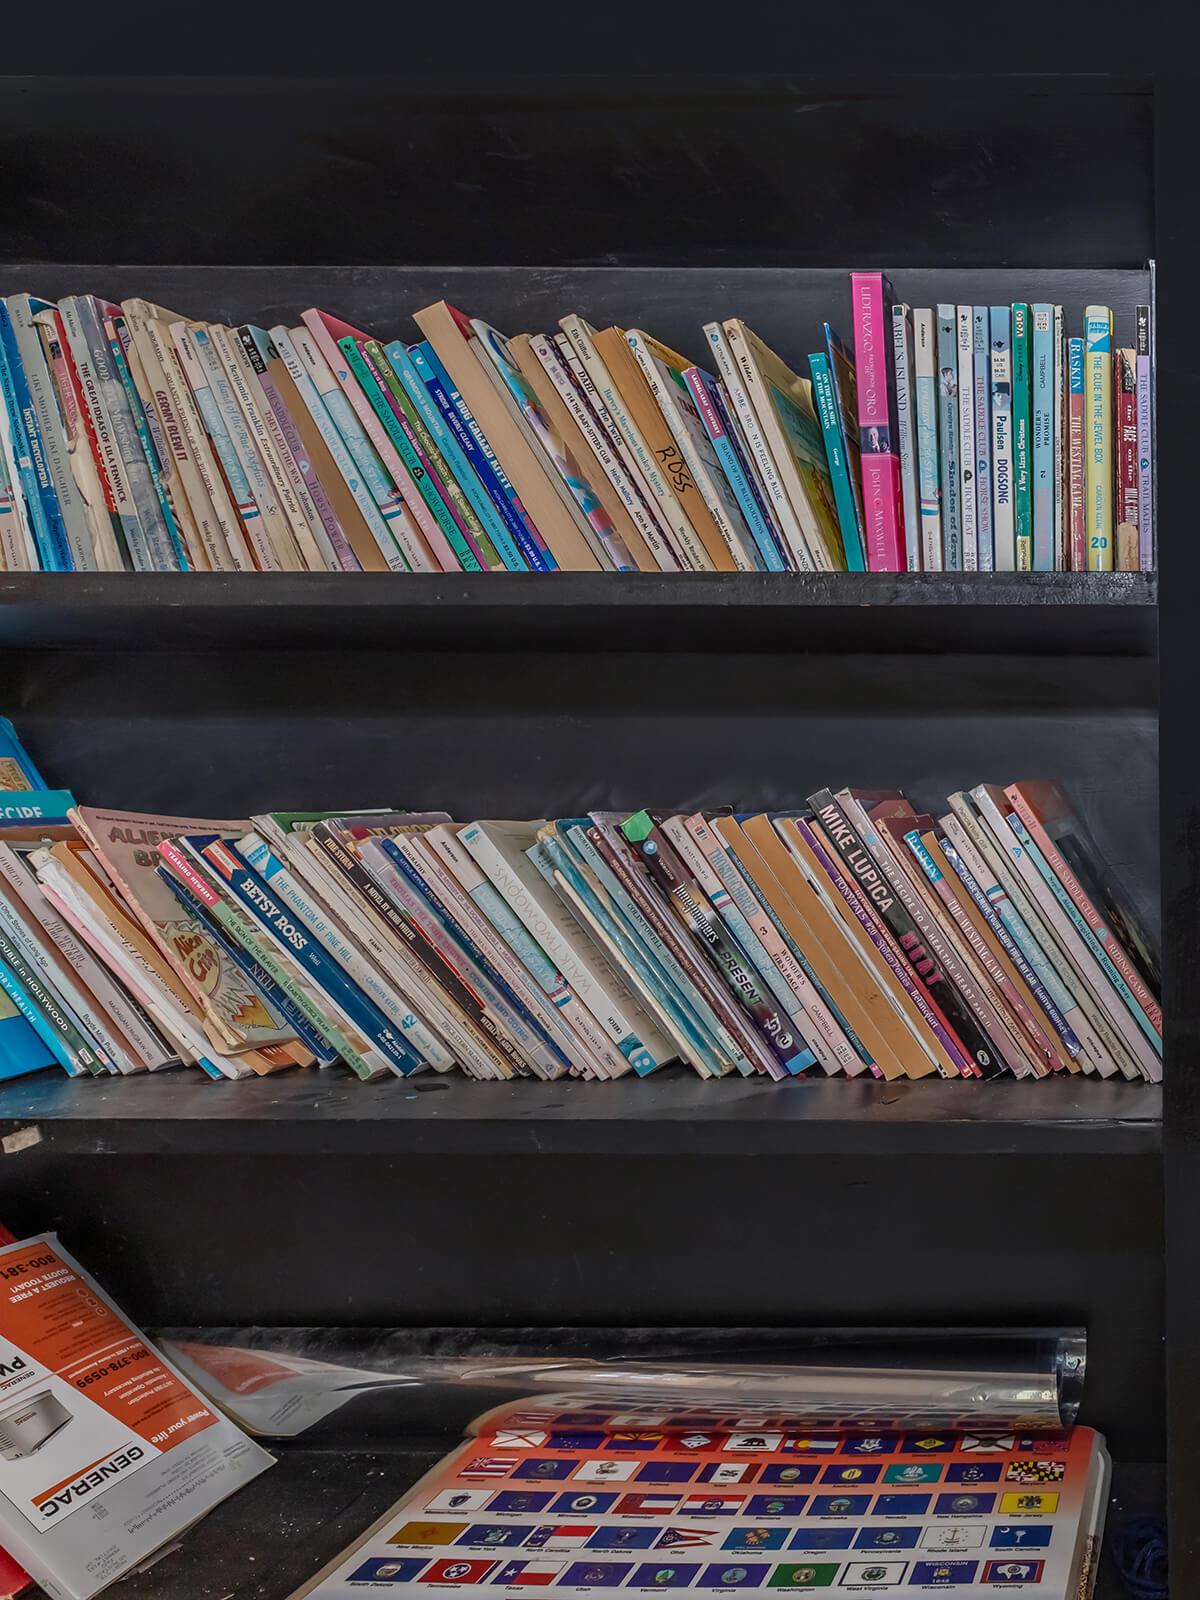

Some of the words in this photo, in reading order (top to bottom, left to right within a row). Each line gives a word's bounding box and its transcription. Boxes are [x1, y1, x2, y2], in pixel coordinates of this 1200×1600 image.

[892, 320, 904, 361] ABEL'S
[79, 361, 91, 379] THE
[1070, 343, 1081, 390] RASKIN
[83, 378, 99, 405] GREAT
[449, 390, 460, 400] A
[576, 369, 596, 396] DAHL
[597, 405, 611, 423] The
[606, 421, 624, 446] Twits
[894, 366, 907, 412] ISLAND
[91, 404, 107, 431] IDEAS
[153, 388, 177, 425] GERMY
[165, 422, 185, 452] BLEW
[175, 449, 189, 463] IT
[454, 399, 473, 422] DOG
[99, 430, 110, 444] OF
[467, 420, 495, 460] CALLED
[995, 415, 1007, 450] Paulsen
[103, 445, 116, 464] LILA
[109, 464, 128, 503] FENWICK
[489, 459, 513, 491] KITTY
[570, 402, 581, 414] THE
[598, 449, 611, 465] CLUB
[633, 509, 645, 524] Ann
[645, 530, 661, 551] Martin
[996, 458, 1009, 504] DOGSONG
[816, 802, 858, 851] MIKE
[845, 848, 898, 912] LUPICA
[238, 876, 281, 920] BETSY
[272, 913, 309, 951] ROSS
[274, 875, 290, 892] THE
[285, 887, 319, 925] PHANTOM
[315, 921, 327, 934] OF
[323, 931, 341, 949] PINE
[337, 946, 353, 963] HILL
[716, 949, 767, 1009] PRESENT
[26, 976, 69, 1033] HOLLYWOOD
[165, 1418, 187, 1435] your
[185, 1406, 210, 1426] Power
[150, 1429, 169, 1446] life
[39, 1446, 145, 1517] GENERAC
